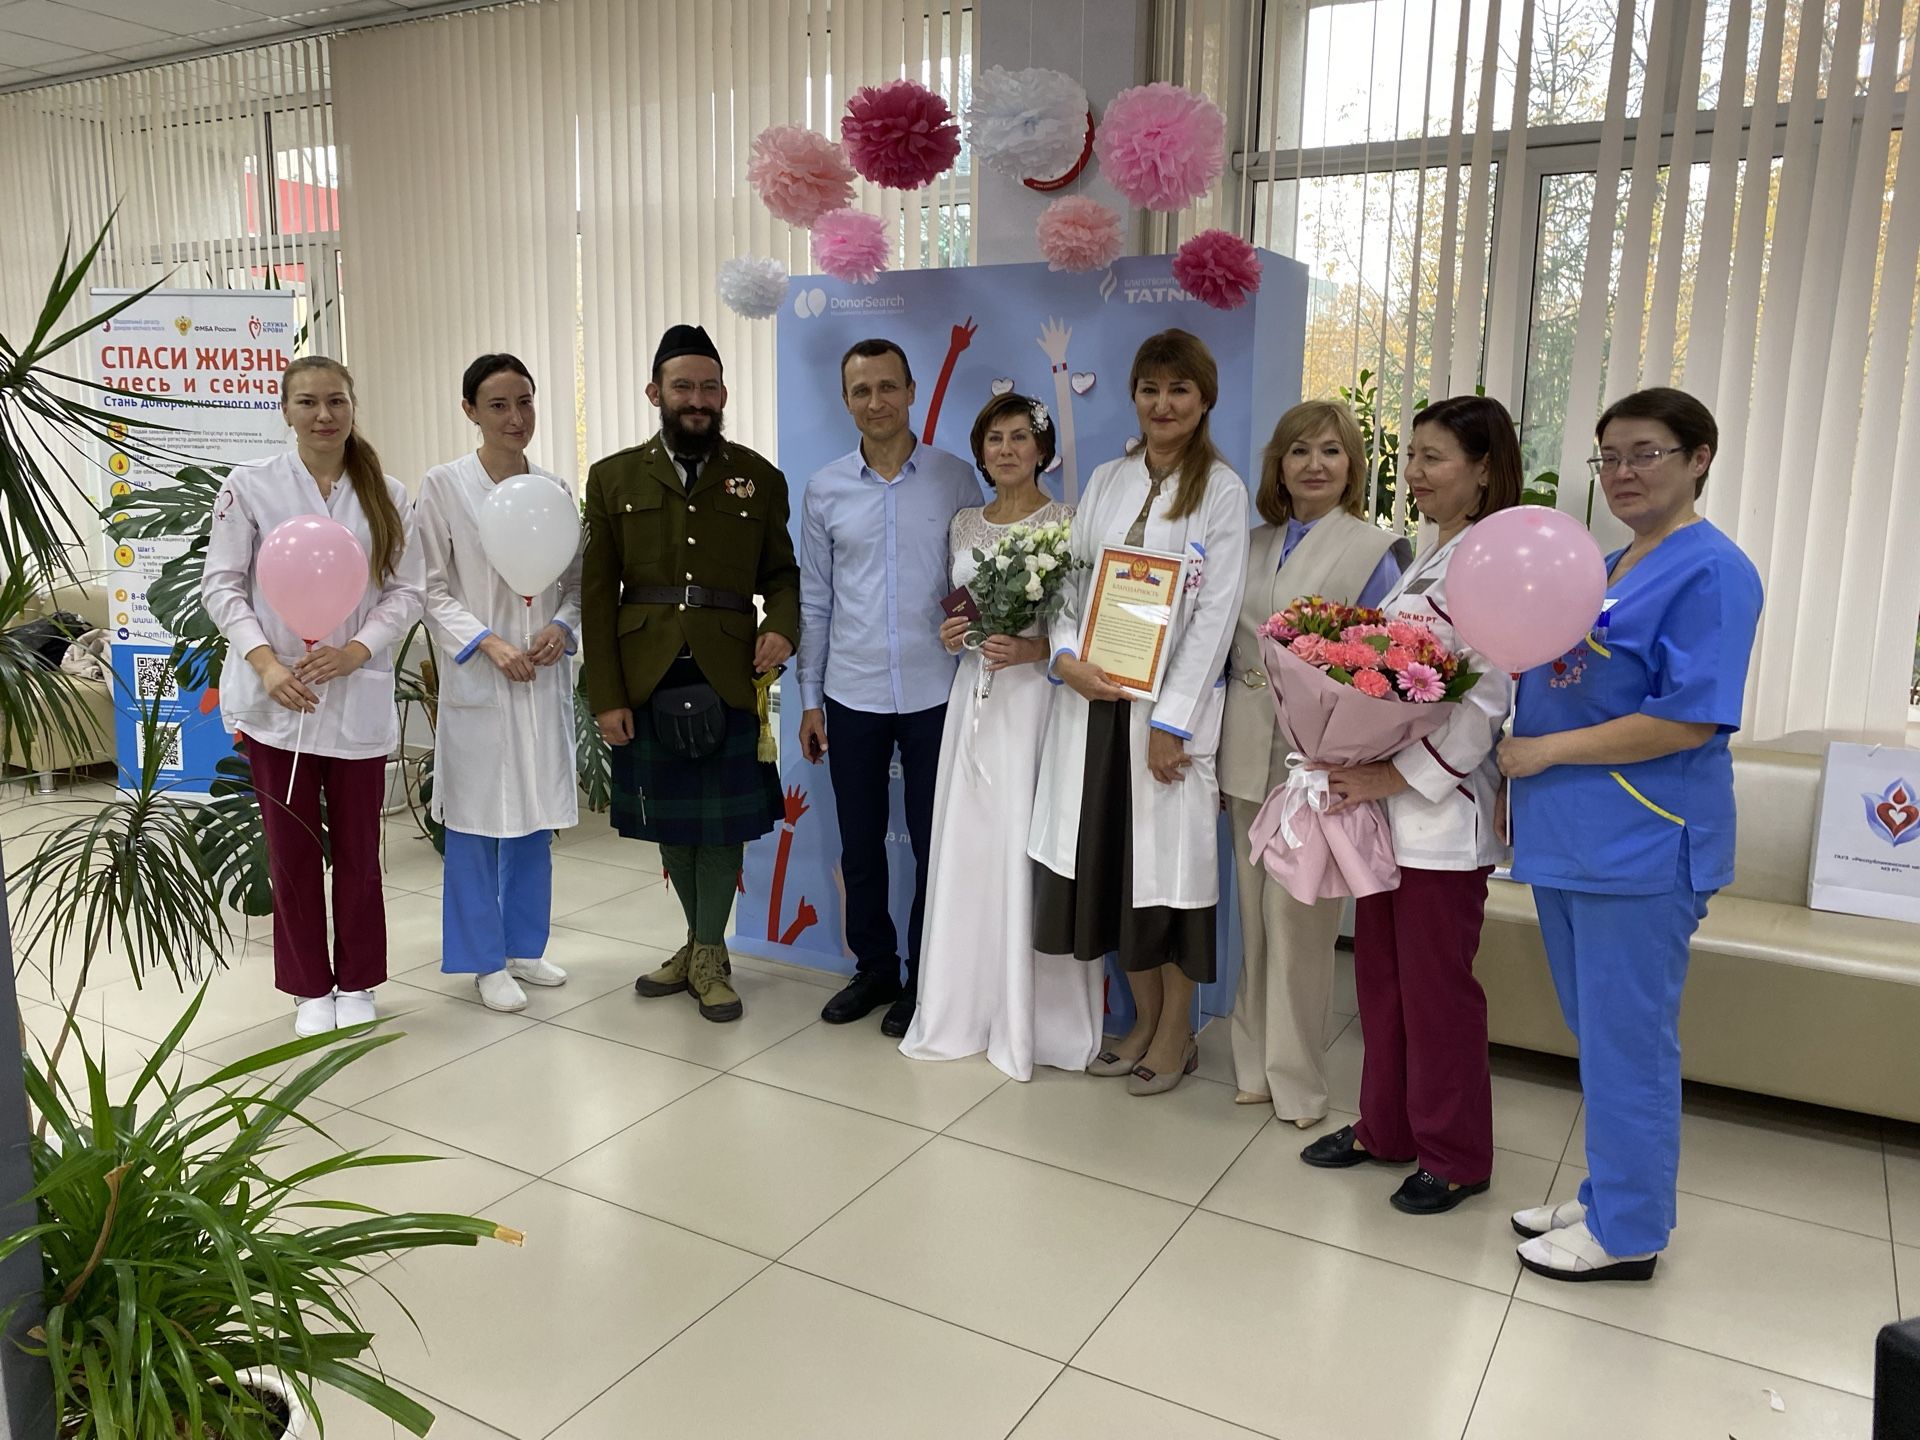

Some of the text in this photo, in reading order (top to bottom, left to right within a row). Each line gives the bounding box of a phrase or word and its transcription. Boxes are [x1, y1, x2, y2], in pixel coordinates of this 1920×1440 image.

[831, 294, 905, 309] DonorSearch
[101, 346, 290, 372] СПАСИ ЖИЗНЬ
[103, 373, 279, 395] здесь и сейча
[103, 395, 138, 407] Стань
[254, 400, 283, 411] мозг
[131, 592, 146, 601] 8-8
[131, 603, 150, 613] (зво
